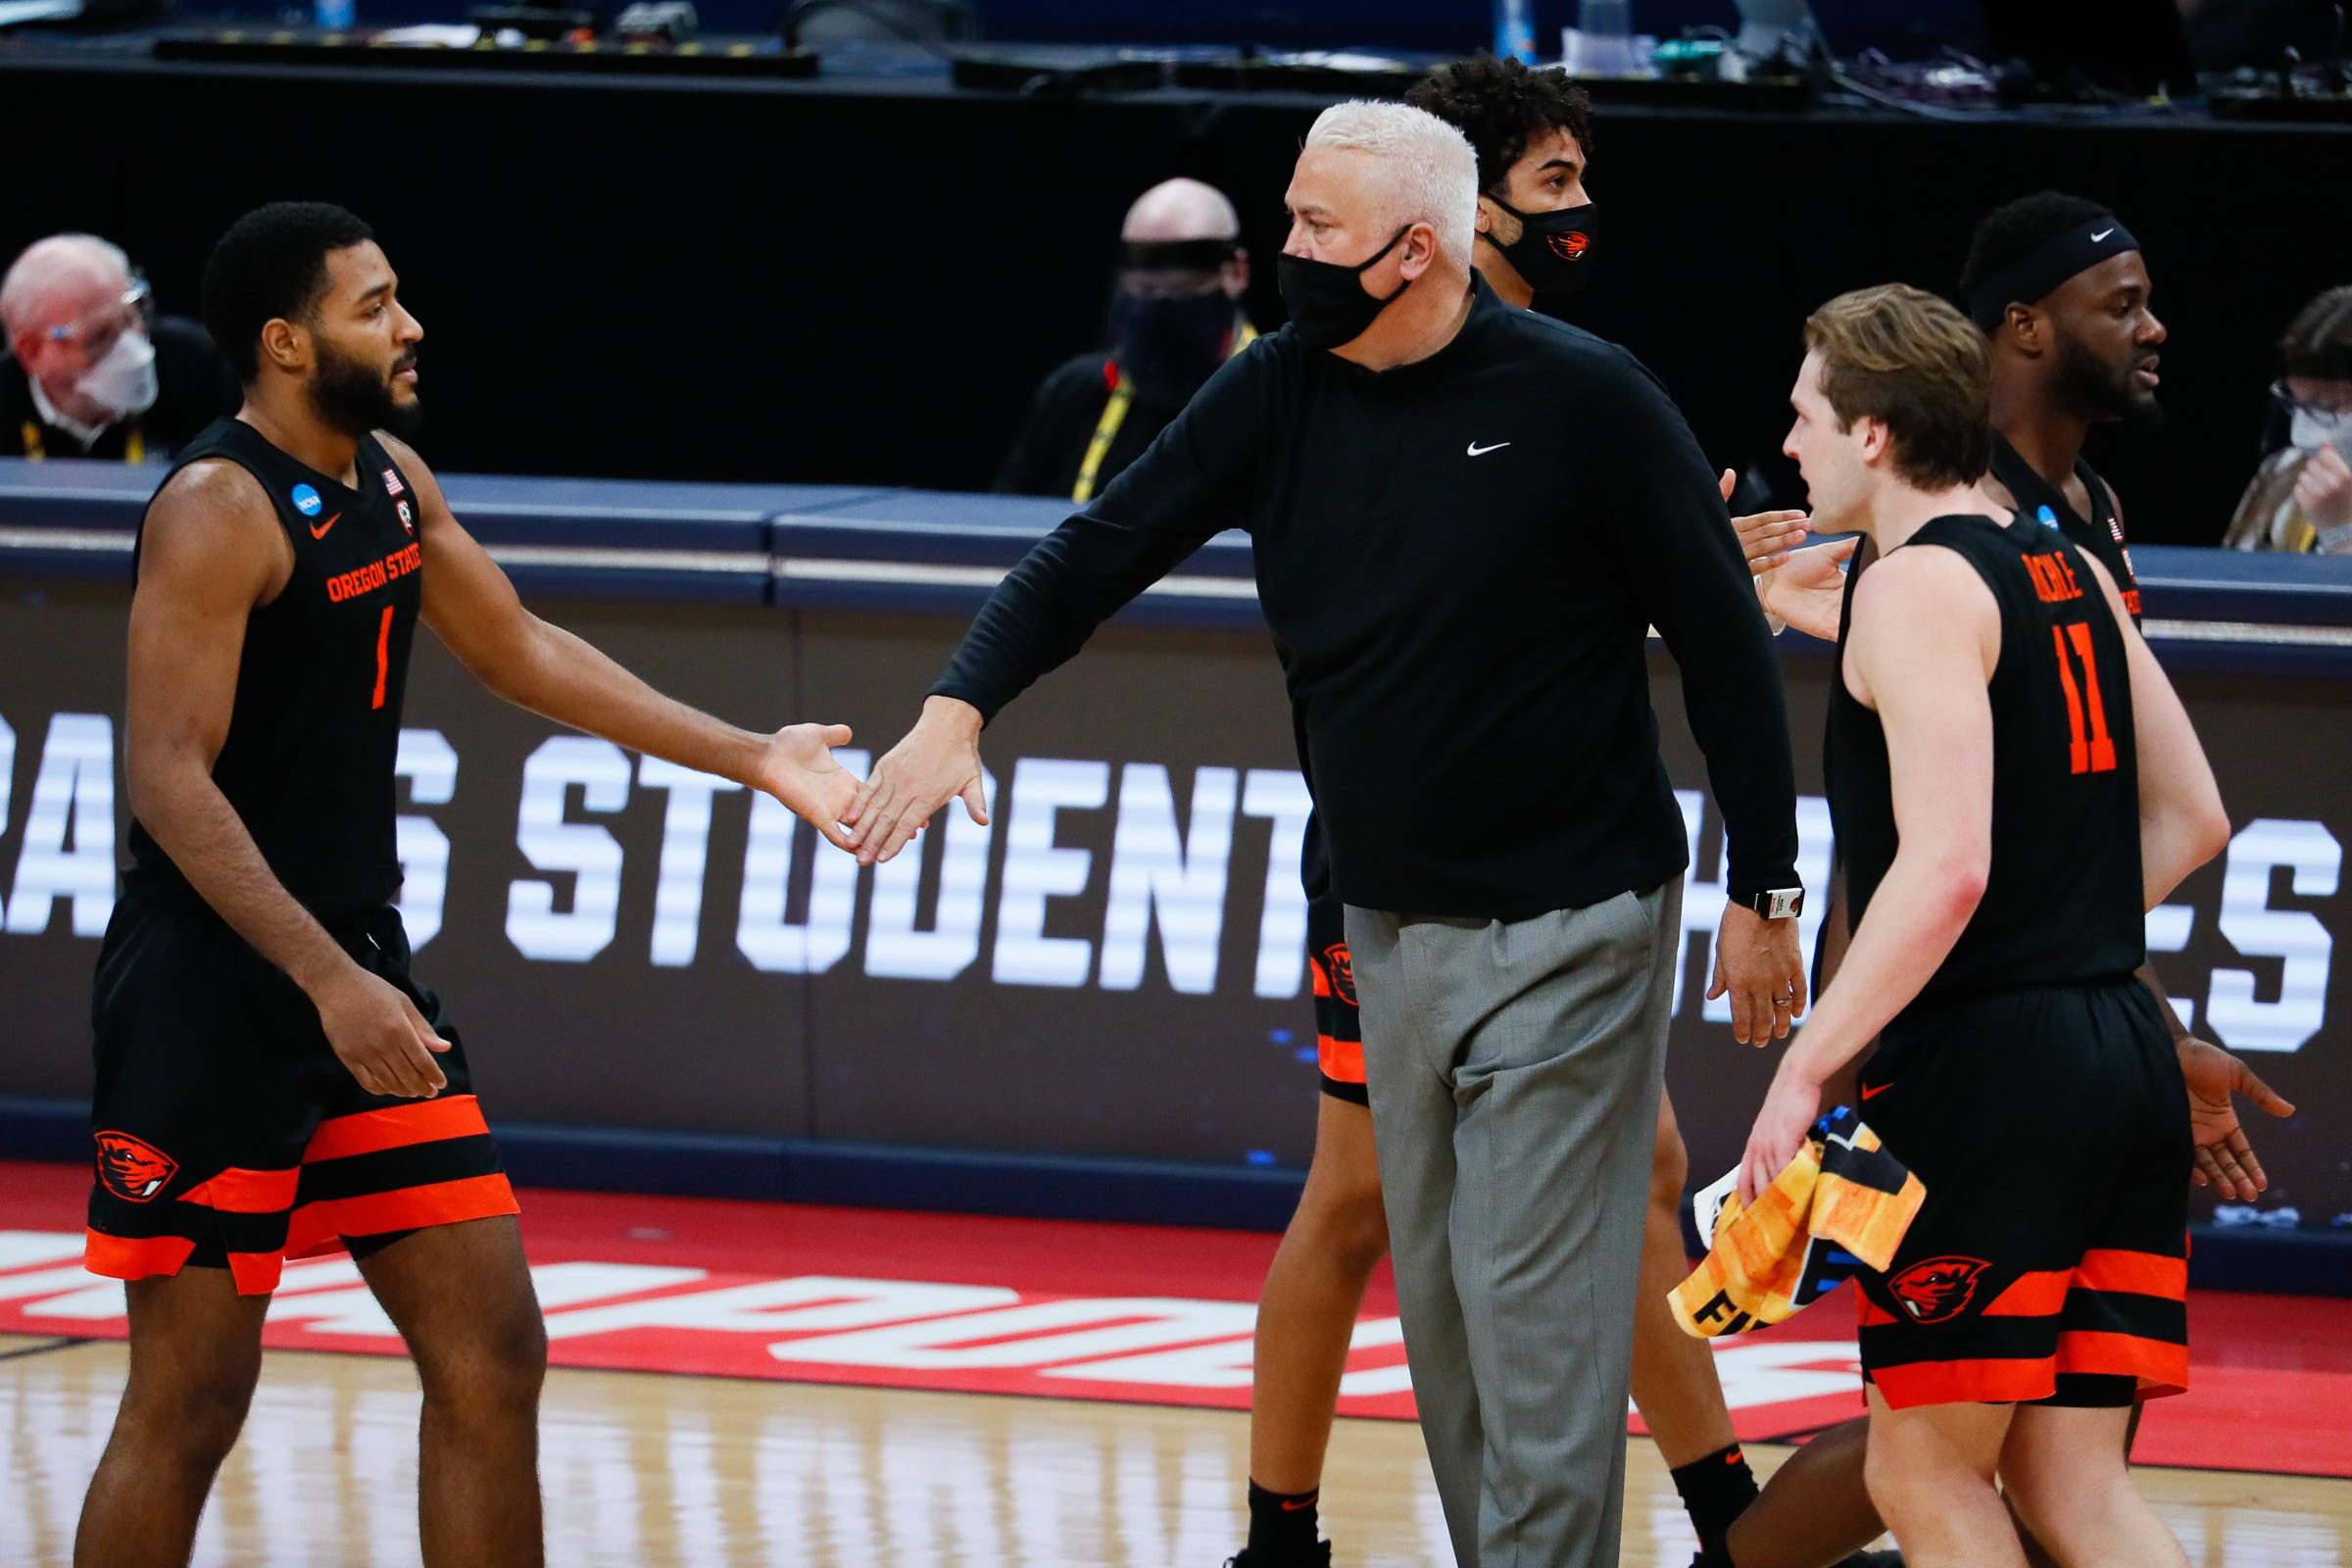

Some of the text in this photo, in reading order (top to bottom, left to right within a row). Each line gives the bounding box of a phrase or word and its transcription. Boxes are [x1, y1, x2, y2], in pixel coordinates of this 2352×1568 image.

[326, 542, 422, 603] OREGON STATE
[372, 606, 394, 710] 1
[2052, 622, 2117, 774] 11
